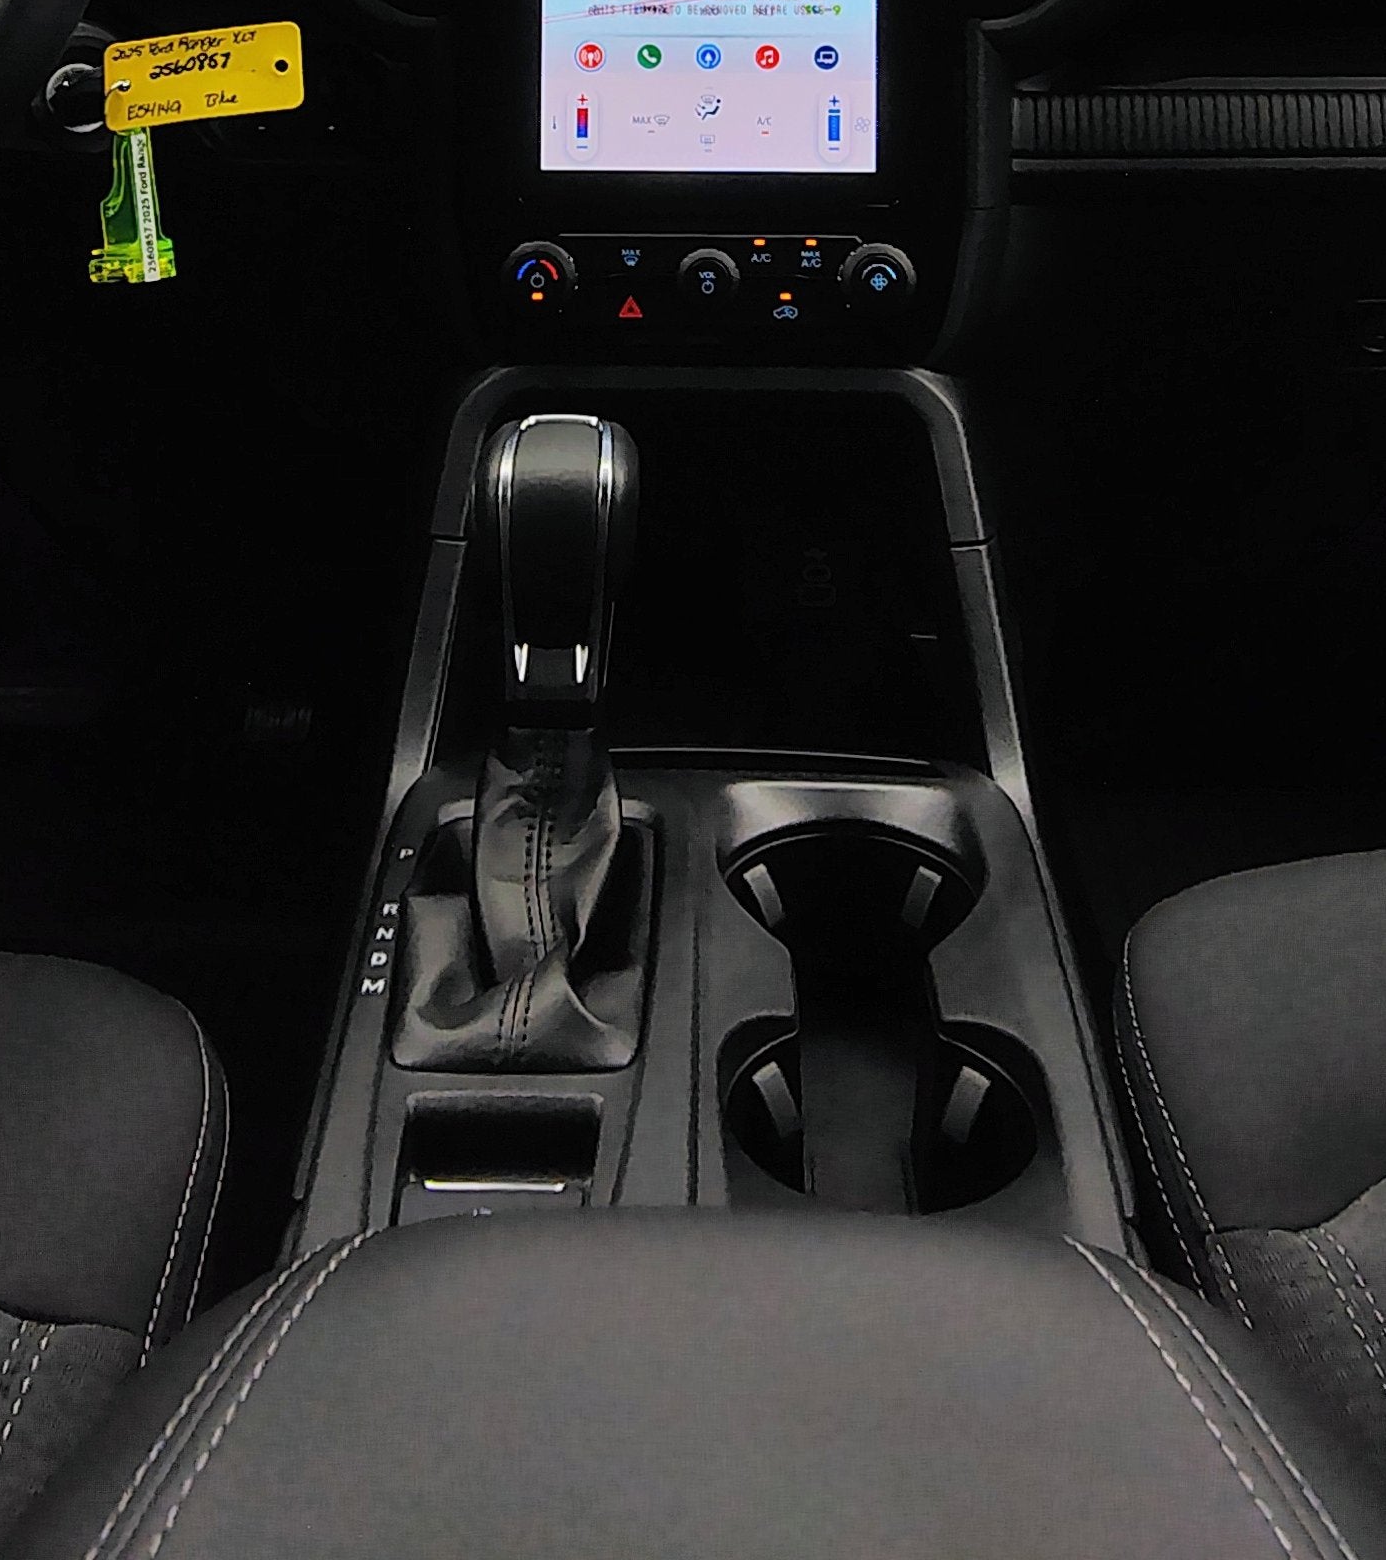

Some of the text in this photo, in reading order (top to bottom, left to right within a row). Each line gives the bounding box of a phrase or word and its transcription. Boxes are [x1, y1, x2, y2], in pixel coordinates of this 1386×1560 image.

[399, 848, 414, 859] P
[382, 903, 400, 916] R
[375, 927, 395, 940] N
[370, 951, 388, 967] D
[361, 978, 387, 995] M
